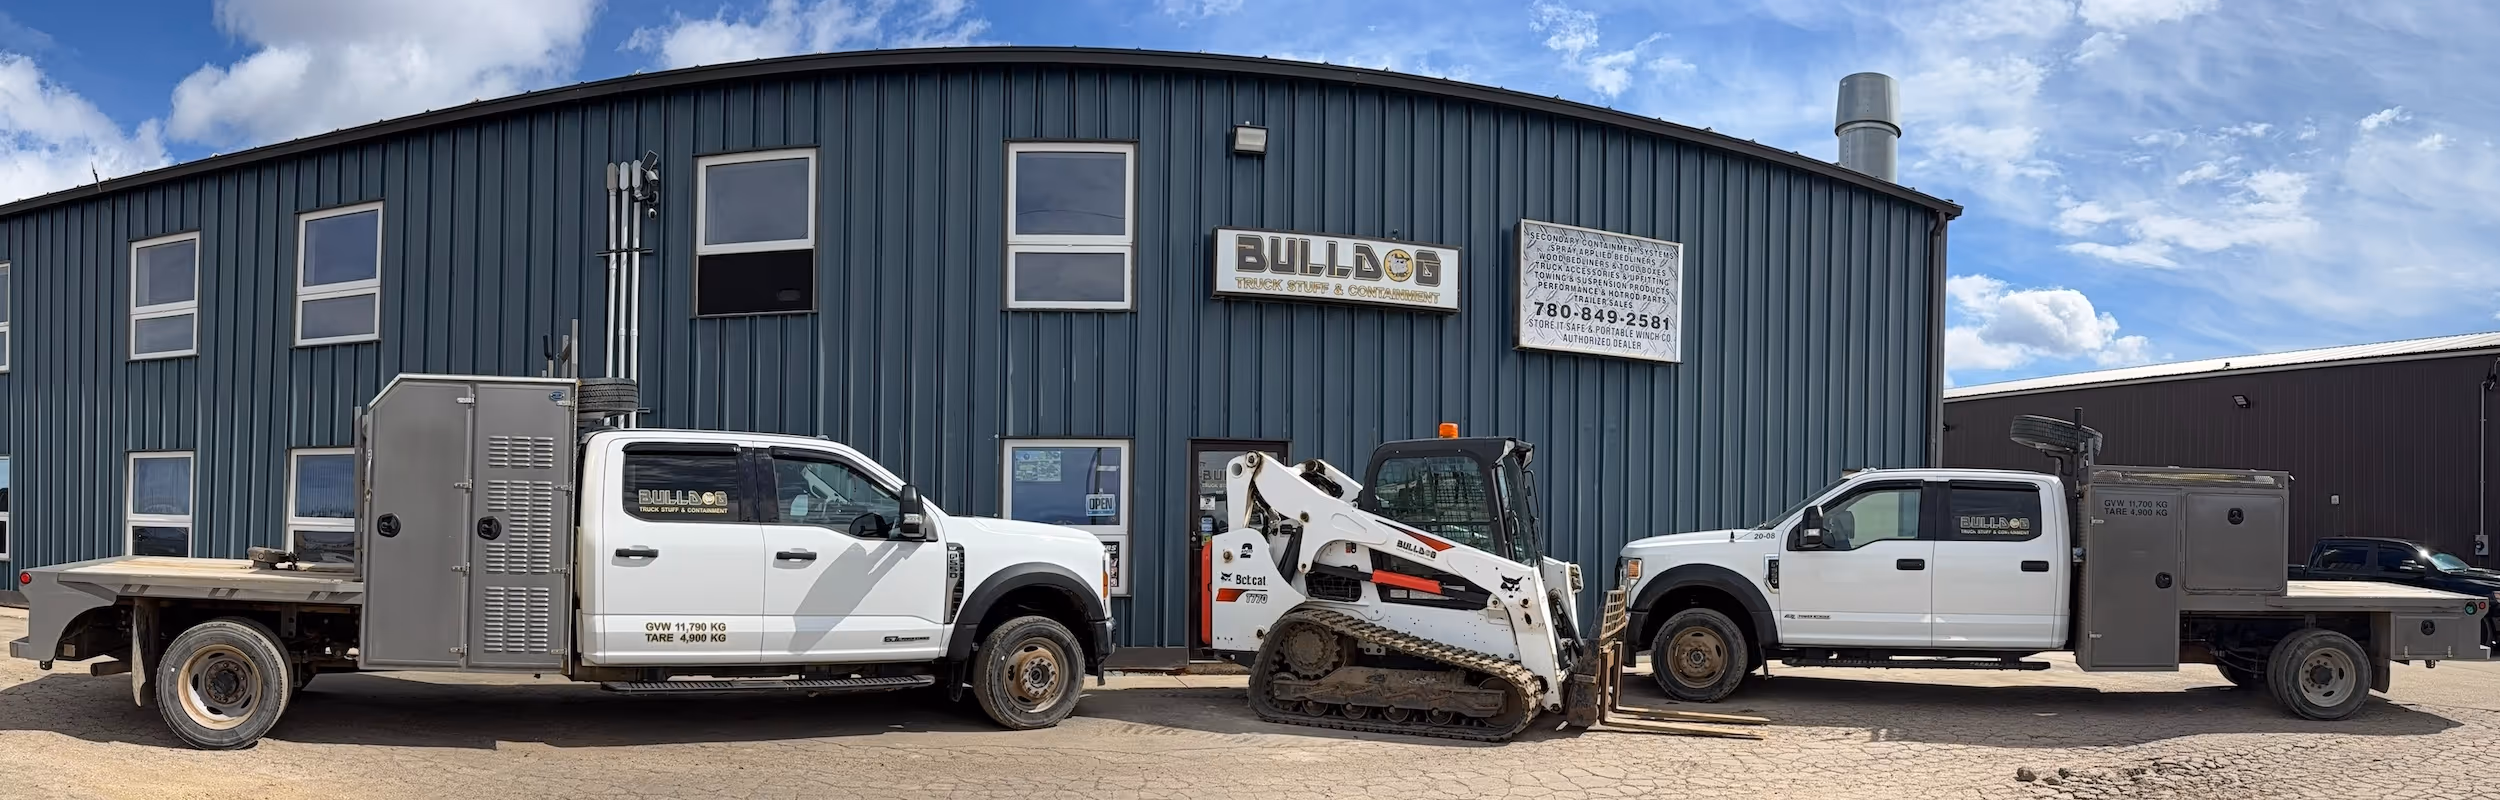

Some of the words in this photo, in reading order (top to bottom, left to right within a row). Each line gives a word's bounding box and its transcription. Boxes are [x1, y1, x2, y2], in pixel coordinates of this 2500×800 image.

[1530, 232, 1579, 244] SECONDARY
[1582, 240, 1637, 253] CONTAINMENT
[1640, 248, 1674, 260] SYSTEMS
[1551, 245, 1576, 254] SPRAY
[1580, 249, 1612, 259] APPLIED
[1615, 254, 1656, 266] BEDLINERS
[1235, 234, 1441, 287] BULLDOG
[1539, 252, 1564, 262] WOOD
[1566, 256, 1609, 268] BEDLINERS
[1535, 271, 1566, 281] TOWING
[1577, 277, 1626, 289] SUSPENSION
[1630, 283, 1670, 295] PRODUCTS
[1536, 262, 1563, 271] TRUCK
[1565, 266, 1620, 279] ACCESSORIES
[1630, 275, 1669, 286] UPFITTING
[1235, 277, 1283, 291] TRUCK
[1287, 280, 1329, 294] STUFF
[1334, 283, 1344, 296] &
[1348, 284, 1440, 304] CONTAINMENT
[1538, 281, 1599, 295] PERFORMANCE
[1608, 290, 1640, 300] HOTROD
[1643, 295, 1666, 304] PARTS
[1574, 295, 1607, 305] TRAILER
[1609, 299, 1633, 309] SALES
[1534, 301, 1669, 330] 780-849-2581
[1528, 319, 1554, 329] STORE
[1557, 321, 1564, 330] IT
[1566, 322, 1585, 333] SAFE
[1588, 325, 1593, 333] &
[1595, 325, 1633, 338] PORTABLE
[1636, 330, 1660, 341] WINCH
[1563, 334, 1610, 346] AUTHORIZED
[1613, 339, 1641, 350] DEALER
[638, 489, 728, 506] BULLDOG
[1089, 497, 1113, 510] OPEN
[1960, 516, 2030, 529] BULLDOG
[1397, 539, 1437, 559] BULLDOG
[1245, 593, 1268, 604] T770
[645, 622, 671, 631] GVW
[675, 622, 707, 633] 11,790
[710, 622, 726, 631] KG
[645, 633, 674, 642] TARE
[680, 633, 707, 644] 4,900
[710, 633, 726, 642] KG
